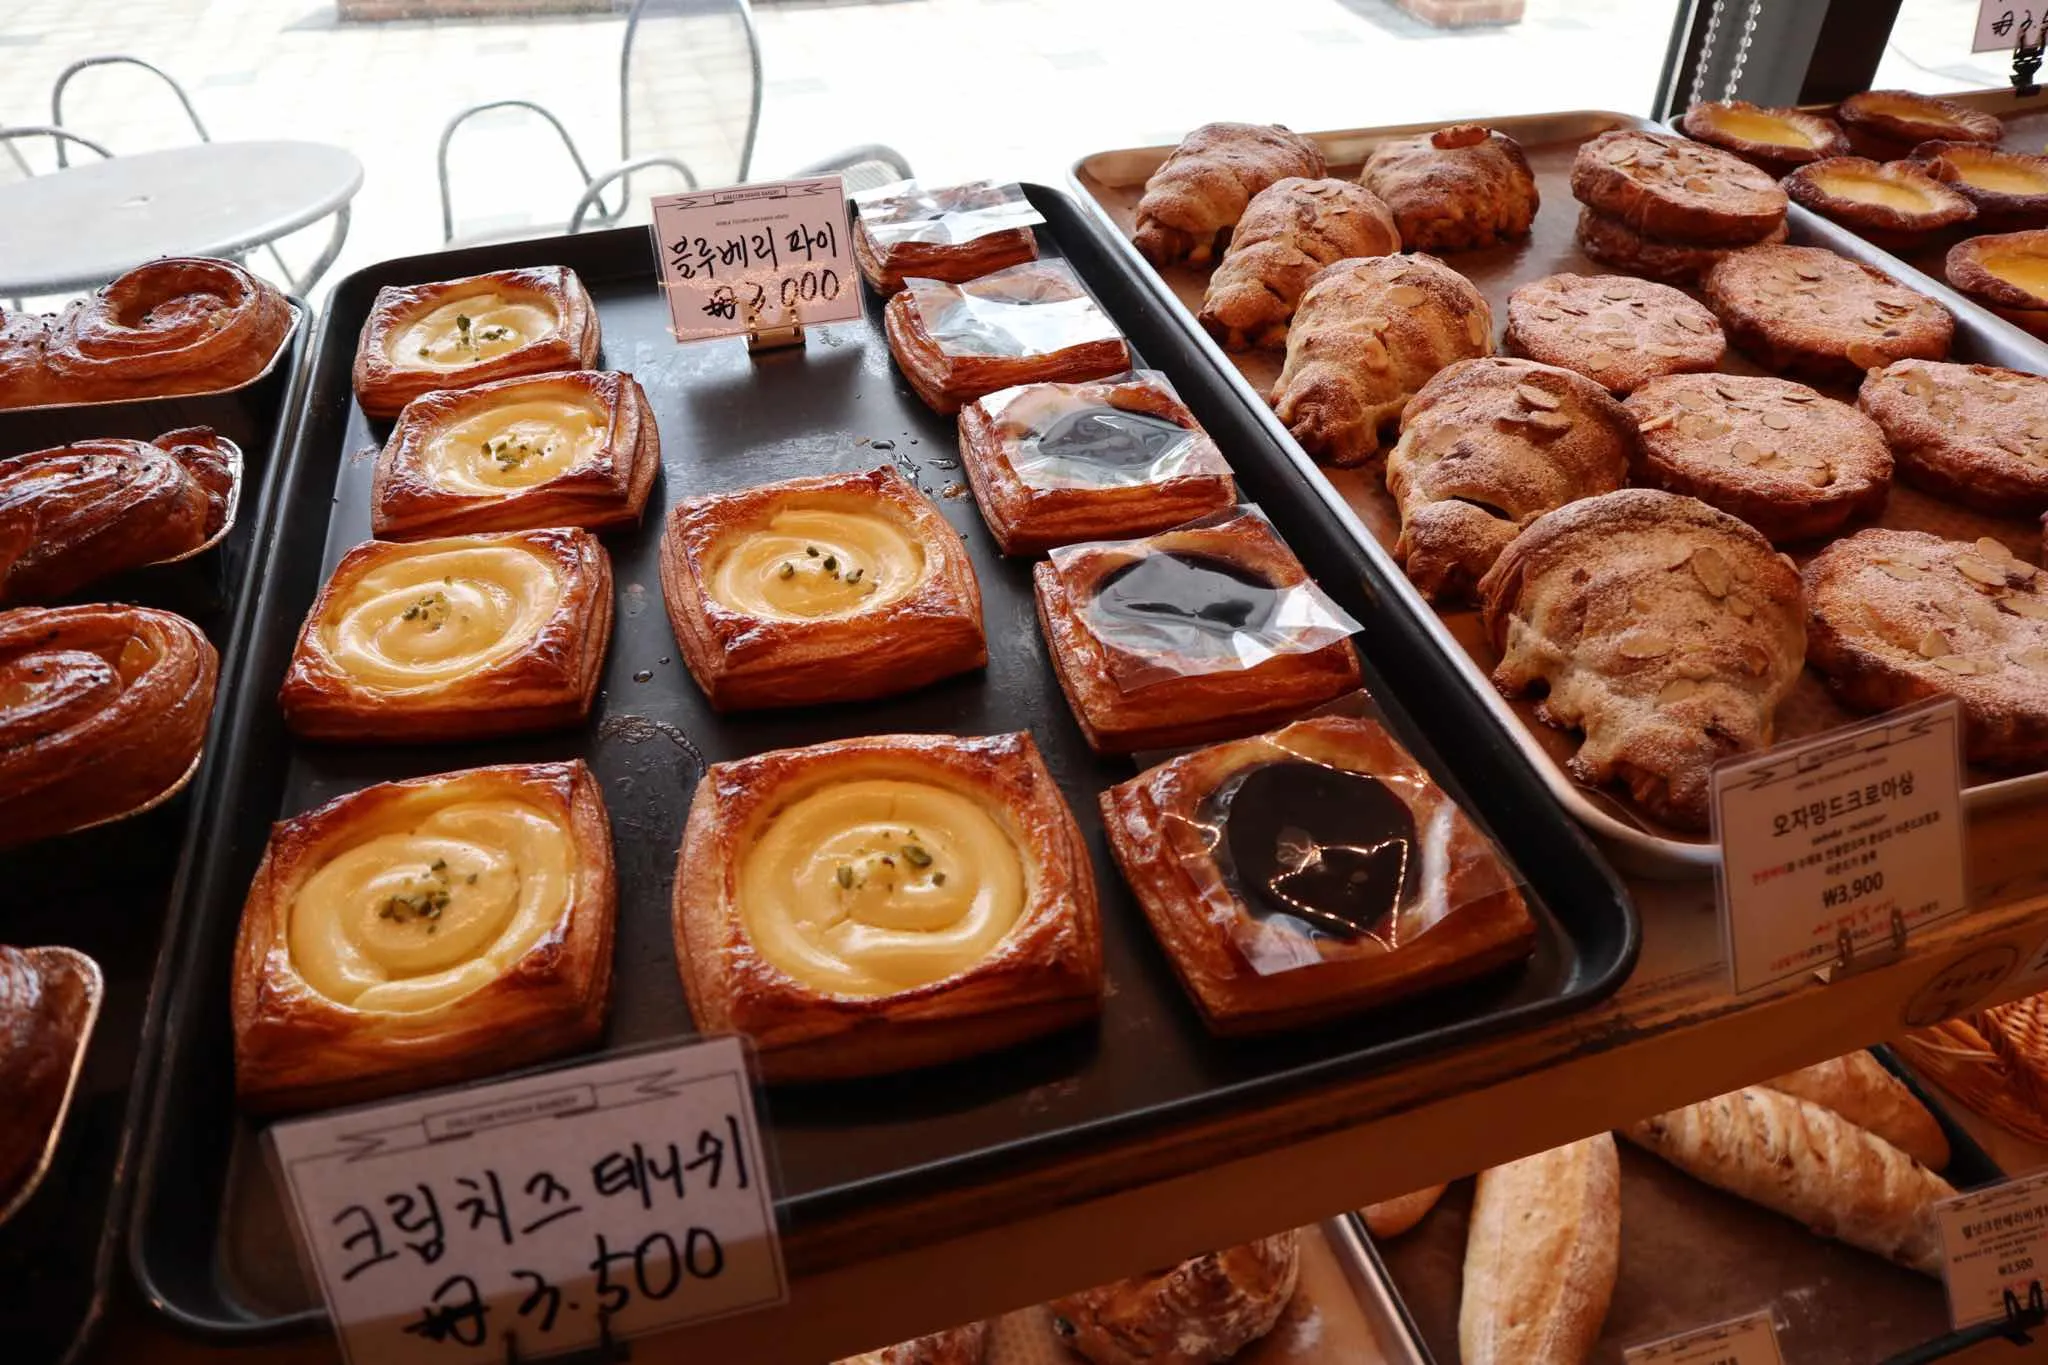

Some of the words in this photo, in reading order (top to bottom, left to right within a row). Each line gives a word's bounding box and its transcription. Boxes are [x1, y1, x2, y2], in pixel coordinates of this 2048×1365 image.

[1991, 10, 2048, 37] ₩3.
[668, 226, 779, 279] 블루베리
[785, 221, 837, 261] 파이
[1771, 771, 1915, 838] 오자망드크로아상
[1822, 871, 1884, 909] ₩3,900
